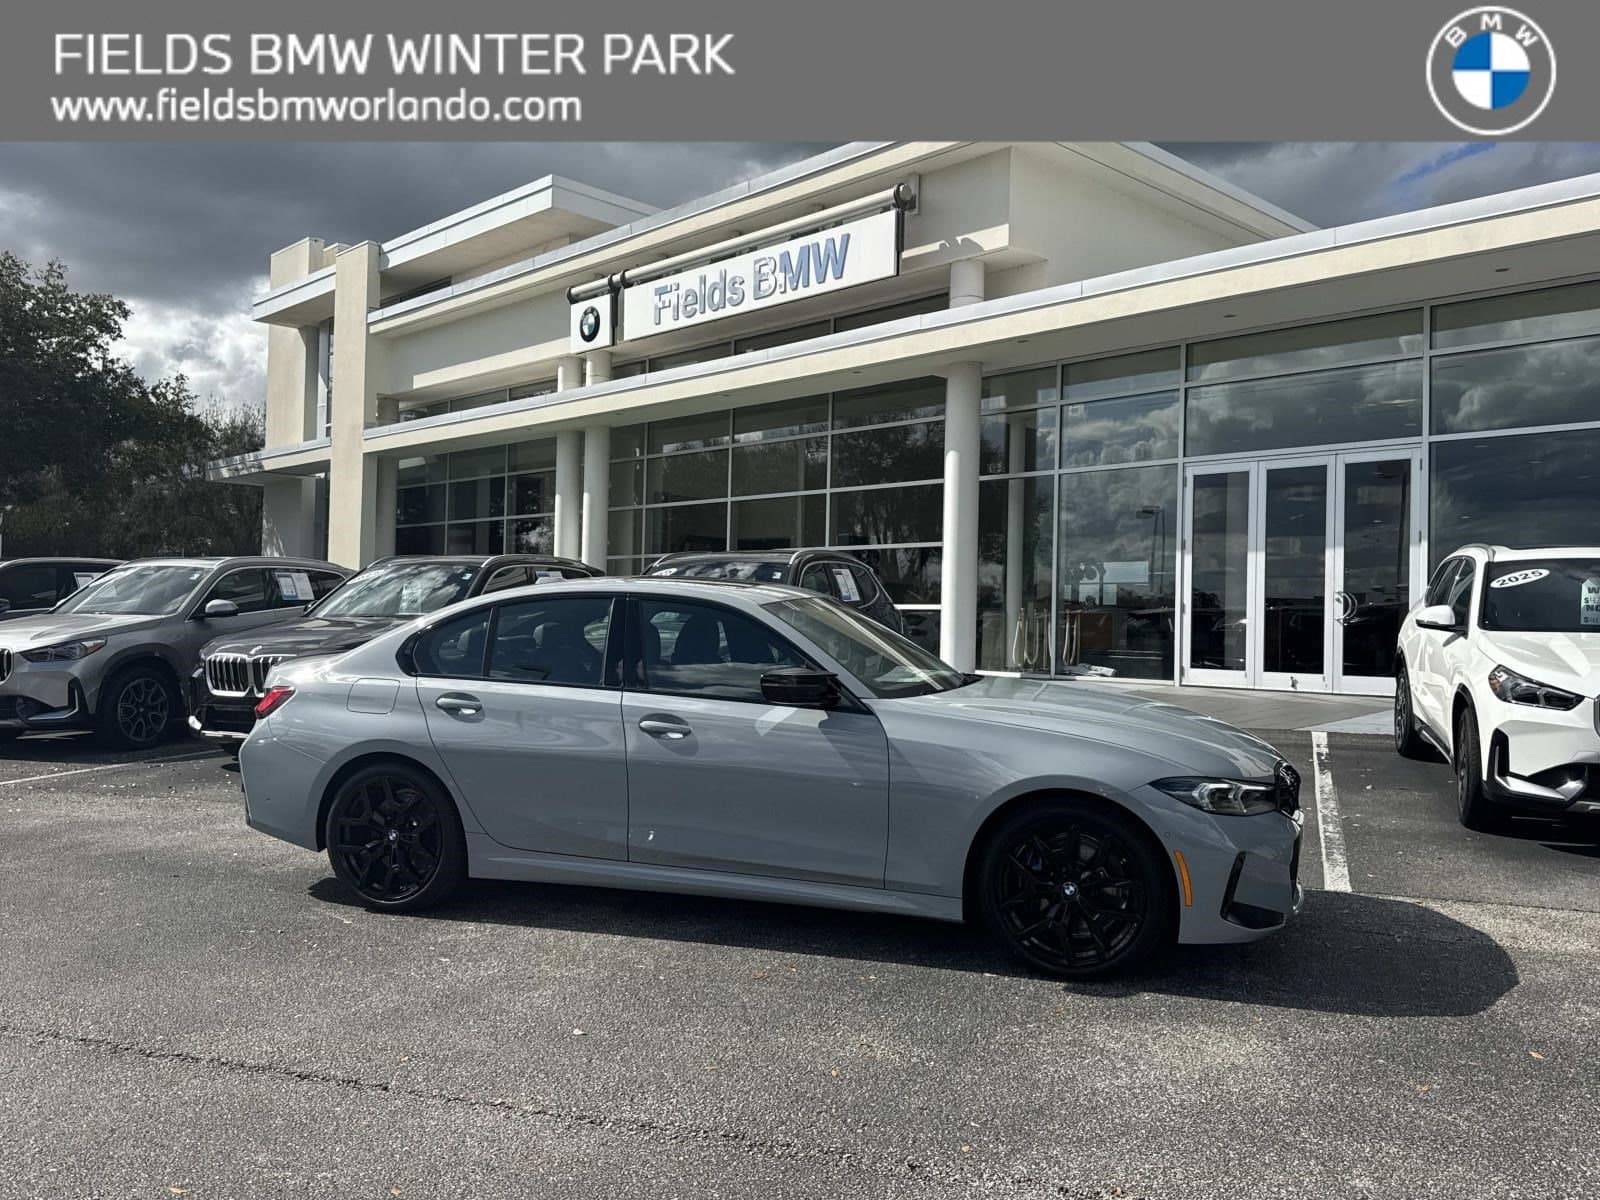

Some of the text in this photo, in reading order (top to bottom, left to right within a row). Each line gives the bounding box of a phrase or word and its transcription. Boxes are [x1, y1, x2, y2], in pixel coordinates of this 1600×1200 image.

[653, 232, 851, 325] Fields BMW
[1496, 569, 1543, 586] 2025
